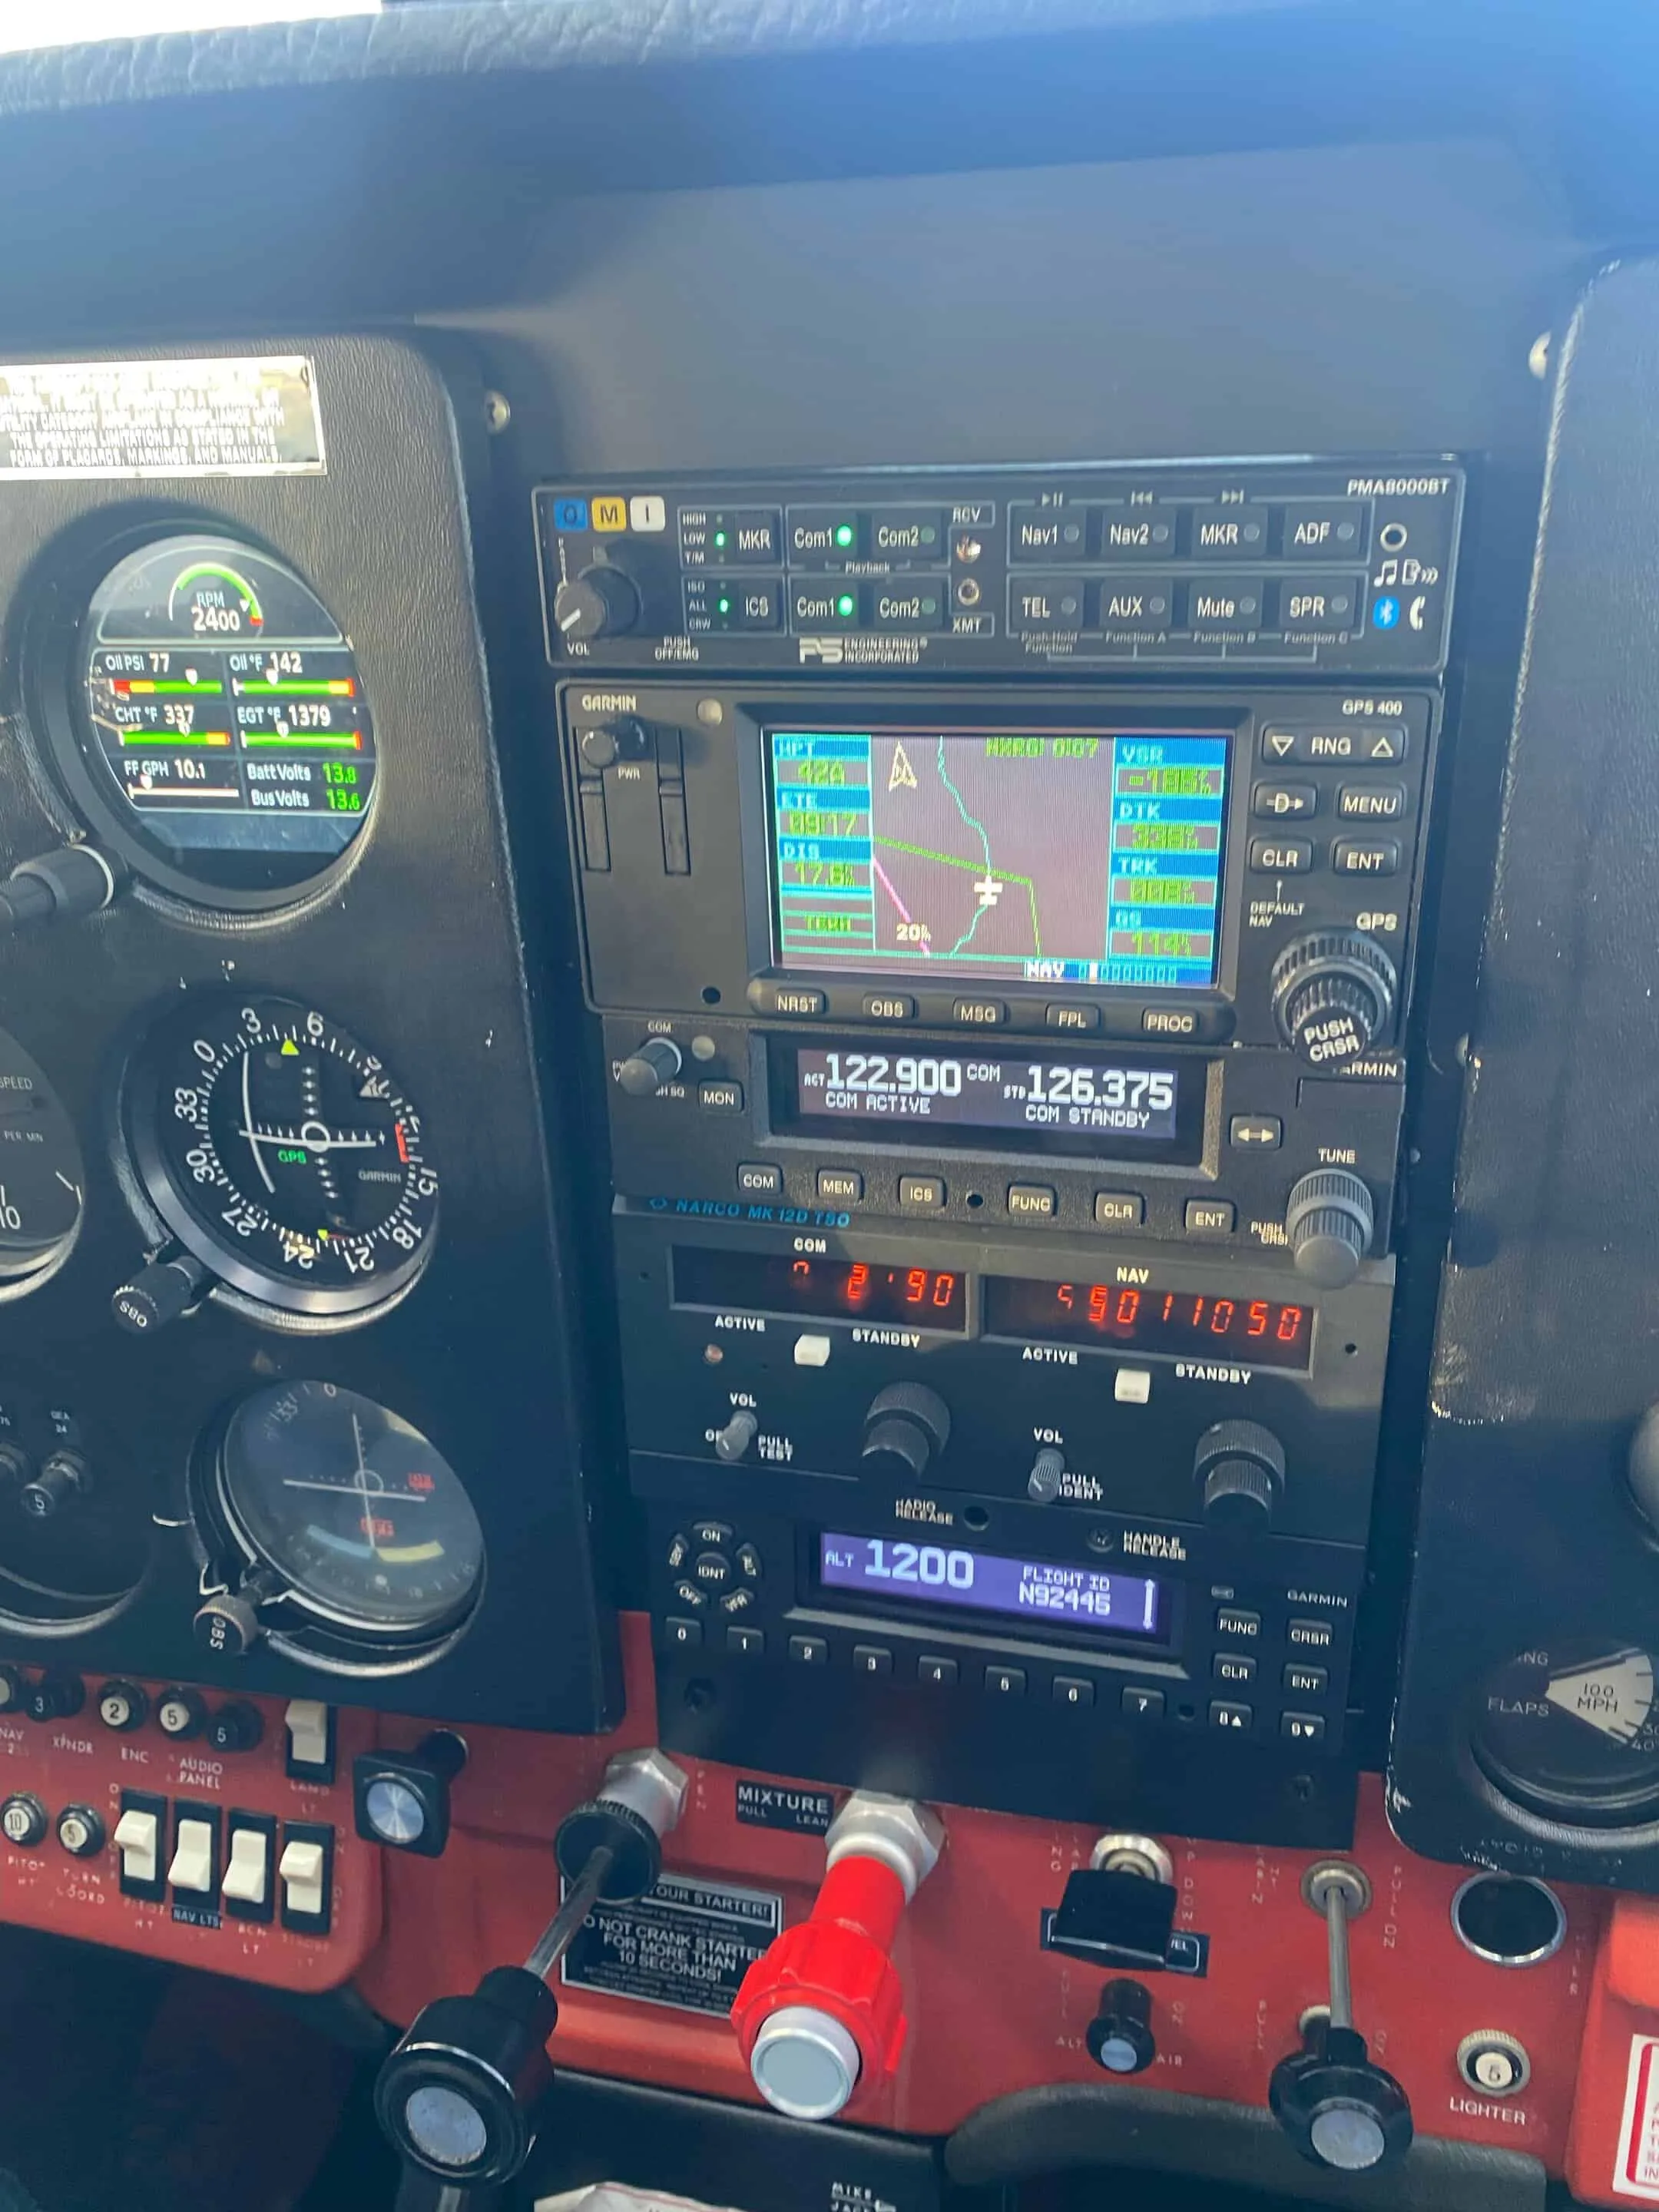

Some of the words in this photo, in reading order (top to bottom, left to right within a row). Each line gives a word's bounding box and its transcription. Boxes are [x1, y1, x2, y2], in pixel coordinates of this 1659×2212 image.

[1347, 478, 1450, 496] PMA8000BT
[601, 504, 618, 524] M
[683, 513, 706, 525] HIGH
[952, 508, 980, 523] RCV
[684, 531, 705, 545] LOW
[738, 530, 770, 550] MKR
[794, 528, 833, 548] Com1
[878, 527, 919, 547] Com2
[1022, 525, 1058, 545] Nav1
[1110, 524, 1148, 545] Nav2
[1200, 524, 1238, 545] MKR
[1294, 522, 1330, 545] ADF
[197, 591, 224, 608] RPM
[689, 600, 707, 611] ALL
[797, 598, 835, 618] Com1
[879, 598, 919, 618] Com2
[1022, 597, 1051, 618] TEL
[1109, 597, 1142, 617] AUX
[1197, 597, 1235, 618] Mute
[1290, 597, 1324, 618] SPR
[191, 608, 240, 631] 2400
[952, 618, 982, 633] XMT
[567, 643, 590, 656] VOL
[105, 654, 123, 671] Oil
[125, 655, 145, 671] PSI
[149, 654, 170, 673] 77
[230, 655, 247, 671] Oil
[270, 654, 302, 674] 142
[582, 694, 637, 712] GARMIN
[1343, 700, 1373, 714] GPS
[115, 706, 141, 722] CHT
[164, 705, 194, 724] 337
[237, 707, 264, 724] EGT
[289, 705, 330, 727] 1379
[1311, 737, 1351, 755] RNG
[174, 760, 205, 779] 10.1
[247, 763, 276, 780] Batt
[276, 763, 311, 781] Volts
[618, 768, 641, 780] PWR
[251, 790, 275, 806] Bus
[275, 790, 309, 807] Volts
[1344, 796, 1396, 814] MENU
[1263, 849, 1298, 868] CLR
[1346, 852, 1384, 871] ENT
[1250, 902, 1305, 916] DEFAULT
[1249, 916, 1272, 928] NAV
[1356, 913, 1398, 931] GPS
[777, 995, 817, 1012] NRST
[871, 1002, 903, 1018] OBS
[241, 1007, 261, 1034] 3
[960, 1006, 996, 1023] MSG
[1058, 1011, 1086, 1028] FPL
[1147, 1015, 1193, 1032] PROC
[307, 1011, 323, 1037] 6
[648, 1021, 671, 1033] COM
[1304, 1017, 1354, 1044] PUSH
[194, 1039, 215, 1063] 0
[826, 1054, 962, 1097] 122.900
[966, 1063, 1000, 1082] COM
[1028, 1065, 1174, 1111] 126.375
[174, 1087, 198, 1122] 33
[704, 1091, 734, 1105] MON
[826, 1092, 858, 1110] COM
[866, 1094, 931, 1114] ACTIVE
[1025, 1104, 1060, 1123] COM
[1068, 1108, 1150, 1130] STANDBY
[278, 1149, 306, 1165] GPS
[1318, 1148, 1356, 1164] TUNE
[186, 1148, 215, 1183] 30
[359, 1170, 402, 1184] GARMIN
[419, 1167, 439, 1195] 15
[743, 1172, 774, 1190] COM
[823, 1177, 854, 1196] MEM
[676, 1199, 740, 1217] NARCO
[1012, 1194, 1051, 1213] FUNC
[1104, 1204, 1133, 1219] CLR
[221, 1207, 259, 1237] 27
[1195, 1213, 1225, 1227] ENT
[392, 1218, 422, 1250] 18
[793, 1238, 826, 1253] COM
[344, 1247, 375, 1273] 21
[1117, 1267, 1149, 1283] NAV
[715, 1316, 765, 1331] ACTIVE
[852, 1329, 919, 1348] STANDBY
[1023, 1348, 1078, 1364] ACTIVE
[1175, 1364, 1250, 1384] STANDBY
[730, 1393, 757, 1407] VOL
[758, 1435, 791, 1449] PULL
[1034, 1428, 1063, 1444] VOL
[760, 1447, 793, 1461] TEST
[1062, 1473, 1098, 1488] PULL
[702, 1529, 720, 1542] ON
[698, 1565, 725, 1579] IDNT
[826, 1551, 853, 1568] ALT
[866, 1540, 974, 1588] 1200
[1024, 1565, 1085, 1588] FLIGHT
[1090, 1573, 1110, 1591] ID
[1019, 1581, 1110, 1614] N92445
[1287, 1590, 1348, 1608] GARMIN
[210, 1616, 227, 1650] OBS
[1220, 1620, 1257, 1636] FUNC
[933, 1667, 942, 1681] 4
[1221, 1665, 1249, 1681] CLR
[1292, 1676, 1319, 1690] ENT
[1584, 1683, 1614, 1697] 100
[35, 1696, 44, 1714] 3
[110, 1703, 119, 1720] 2
[1488, 1697, 1549, 1717] FLAPS
[1577, 1697, 1618, 1714] MPH
[167, 1709, 177, 1726] 5
[0, 1727, 25, 1741] NAV
[217, 1727, 227, 1743] 5
[121, 1747, 149, 1763] ENC
[180, 1757, 223, 1775] AUDIO
[180, 1770, 220, 1790] PANEL
[738, 1786, 829, 1813] MIXTURE
[8, 1811, 22, 1826] 10
[738, 1804, 767, 1819] PULL
[796, 1814, 829, 1827] LEAN
[694, 1892, 767, 1917] STARTER!
[174, 1909, 195, 1922] NAV
[599, 1918, 631, 1934] NOT
[635, 1926, 690, 1948] CRANK
[604, 1932, 636, 1949] FOR
[641, 1942, 688, 1959] MORE
[693, 1952, 736, 1972] THAN
[619, 1951, 634, 1964] 10
[639, 1955, 721, 1982] SECONDS!
[1157, 2054, 1182, 2066] AIR
[1449, 2095, 1525, 2125] LIGHTER
